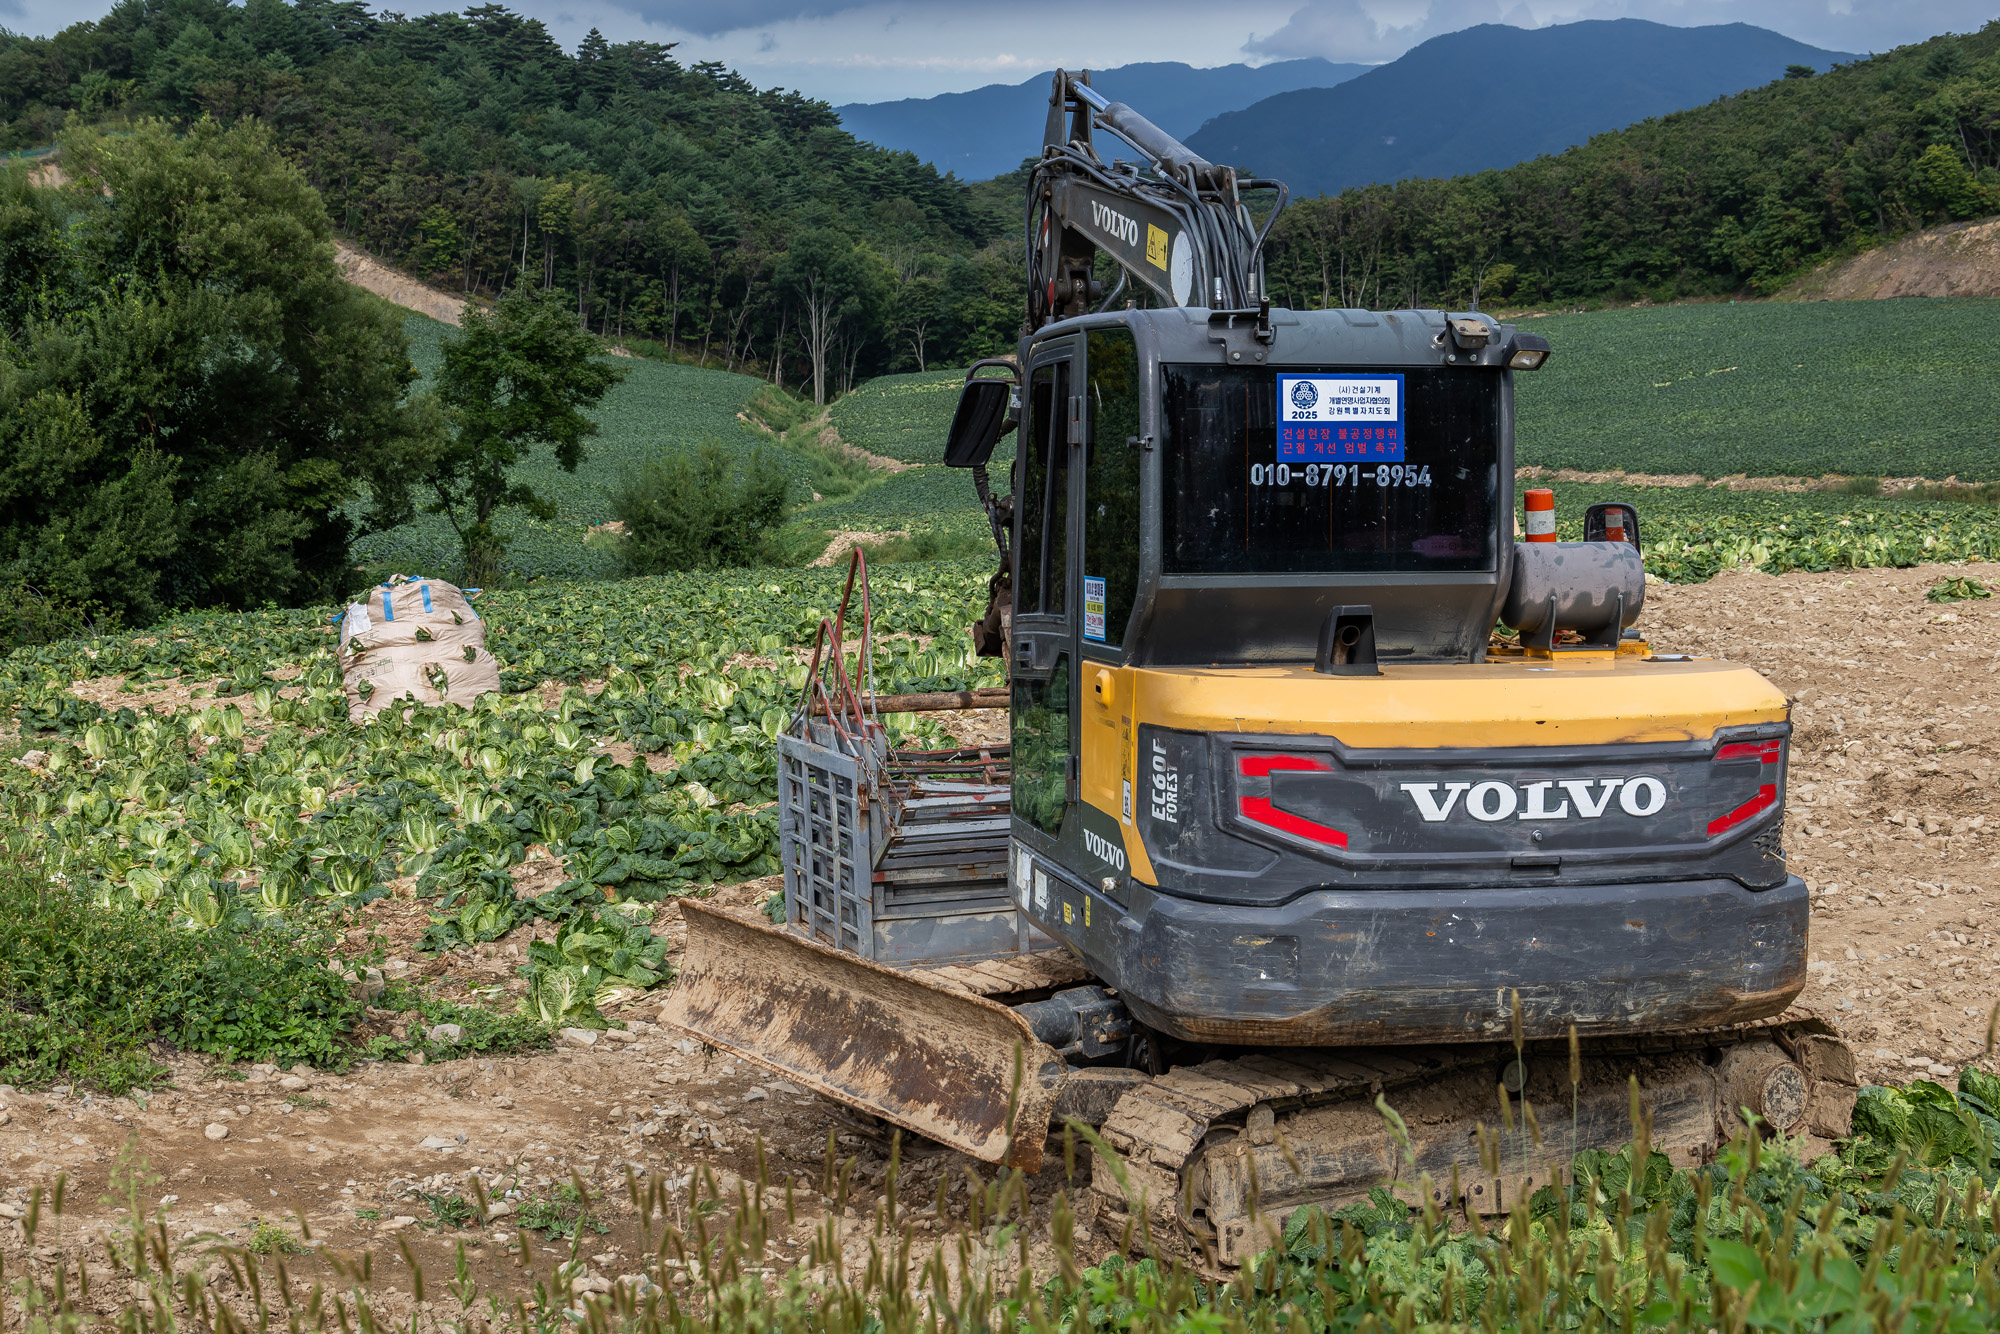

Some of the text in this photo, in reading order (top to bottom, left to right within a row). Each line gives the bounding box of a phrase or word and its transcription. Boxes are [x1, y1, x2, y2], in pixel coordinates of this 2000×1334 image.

[1091, 200, 1139, 247] VOLVO
[1291, 410, 1318, 420] 2025
[1328, 407, 1391, 415] 강원특별자치도회
[1282, 428, 1397, 440] 건설현장 불공정행위
[1282, 443, 1398, 454] 근절 개선 엄벌 촉구
[1250, 463, 1432, 487] 010-8791-8954
[1166, 766, 1178, 824] FOREST
[1400, 776, 1667, 822] VOLVO
[1083, 828, 1125, 872] VOLVO
